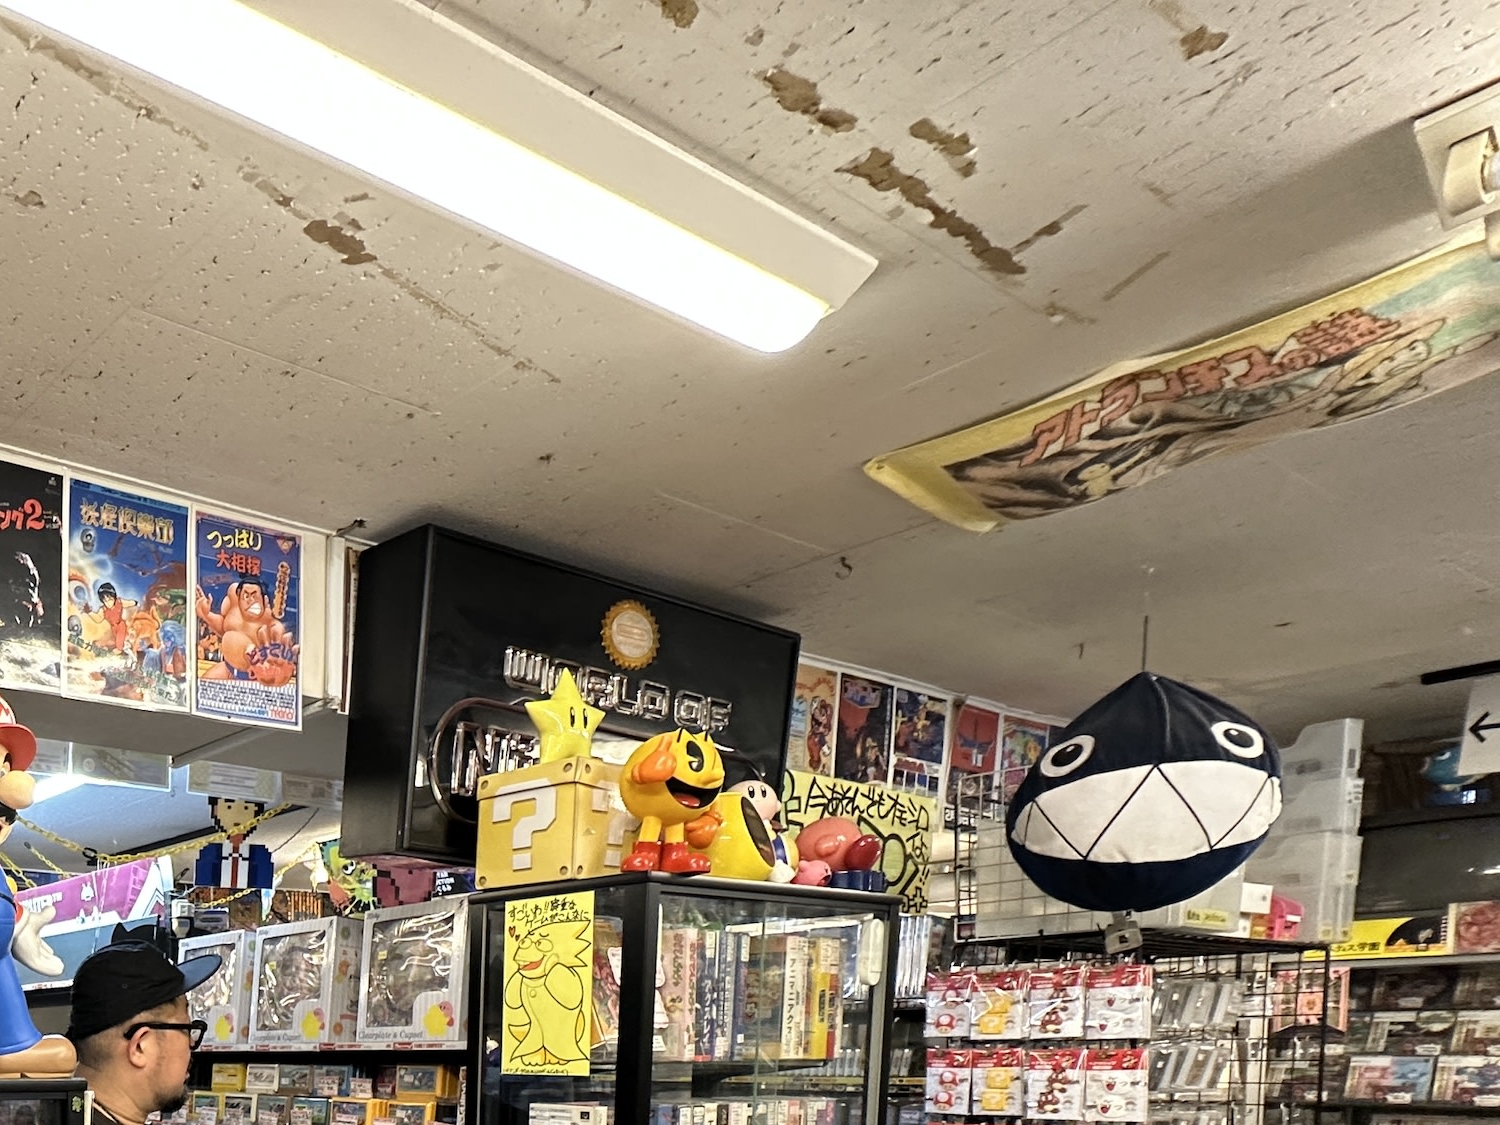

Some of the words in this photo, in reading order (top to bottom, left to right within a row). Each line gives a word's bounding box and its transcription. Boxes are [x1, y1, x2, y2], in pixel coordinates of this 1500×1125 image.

[206, 528, 262, 552] つっぱり
[215, 550, 262, 577] 大相撲
[502, 644, 670, 722] WORLD
[674, 688, 733, 736] OF
